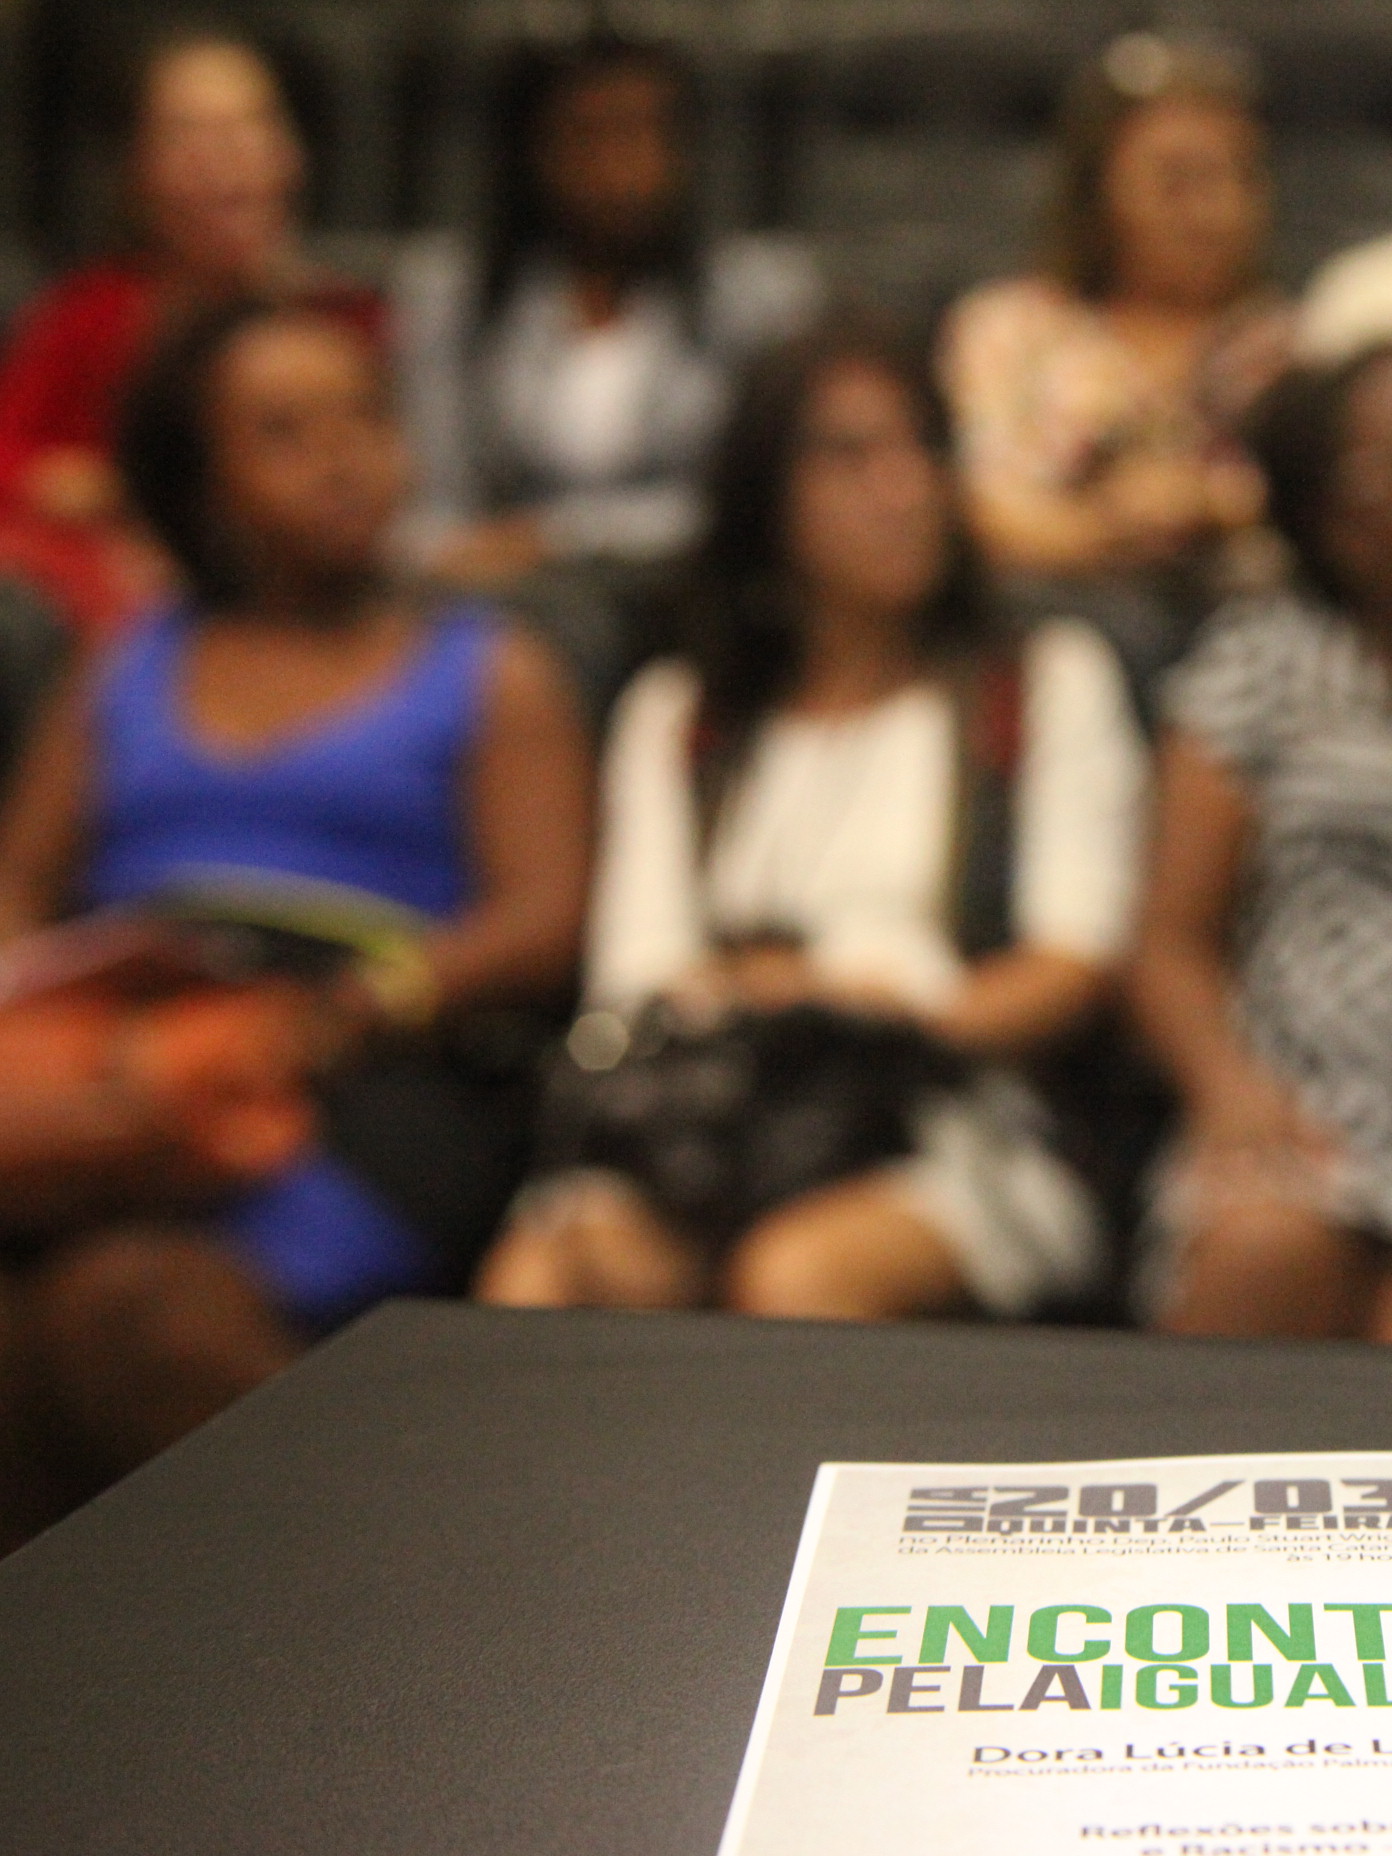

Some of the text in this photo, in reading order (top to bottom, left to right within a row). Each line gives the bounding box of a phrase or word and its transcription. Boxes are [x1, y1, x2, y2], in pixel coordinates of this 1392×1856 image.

[903, 1486, 989, 1532] DIA
[899, 1536, 938, 1545] no
[945, 1534, 1104, 1545] Plenarinho
[1179, 1534, 1250, 1544] Paulo
[1257, 1532, 1333, 1543] Stuart
[898, 1546, 928, 1556] da
[935, 1545, 1077, 1556] Assembleia
[1083, 1544, 1209, 1557] Legislativa
[1215, 1544, 1247, 1554] de
[1253, 1543, 1322, 1553] Santa
[974, 1745, 1104, 1763] Dora
[1125, 1741, 1266, 1760] Lúcia
[1285, 1739, 1353, 1756] de
